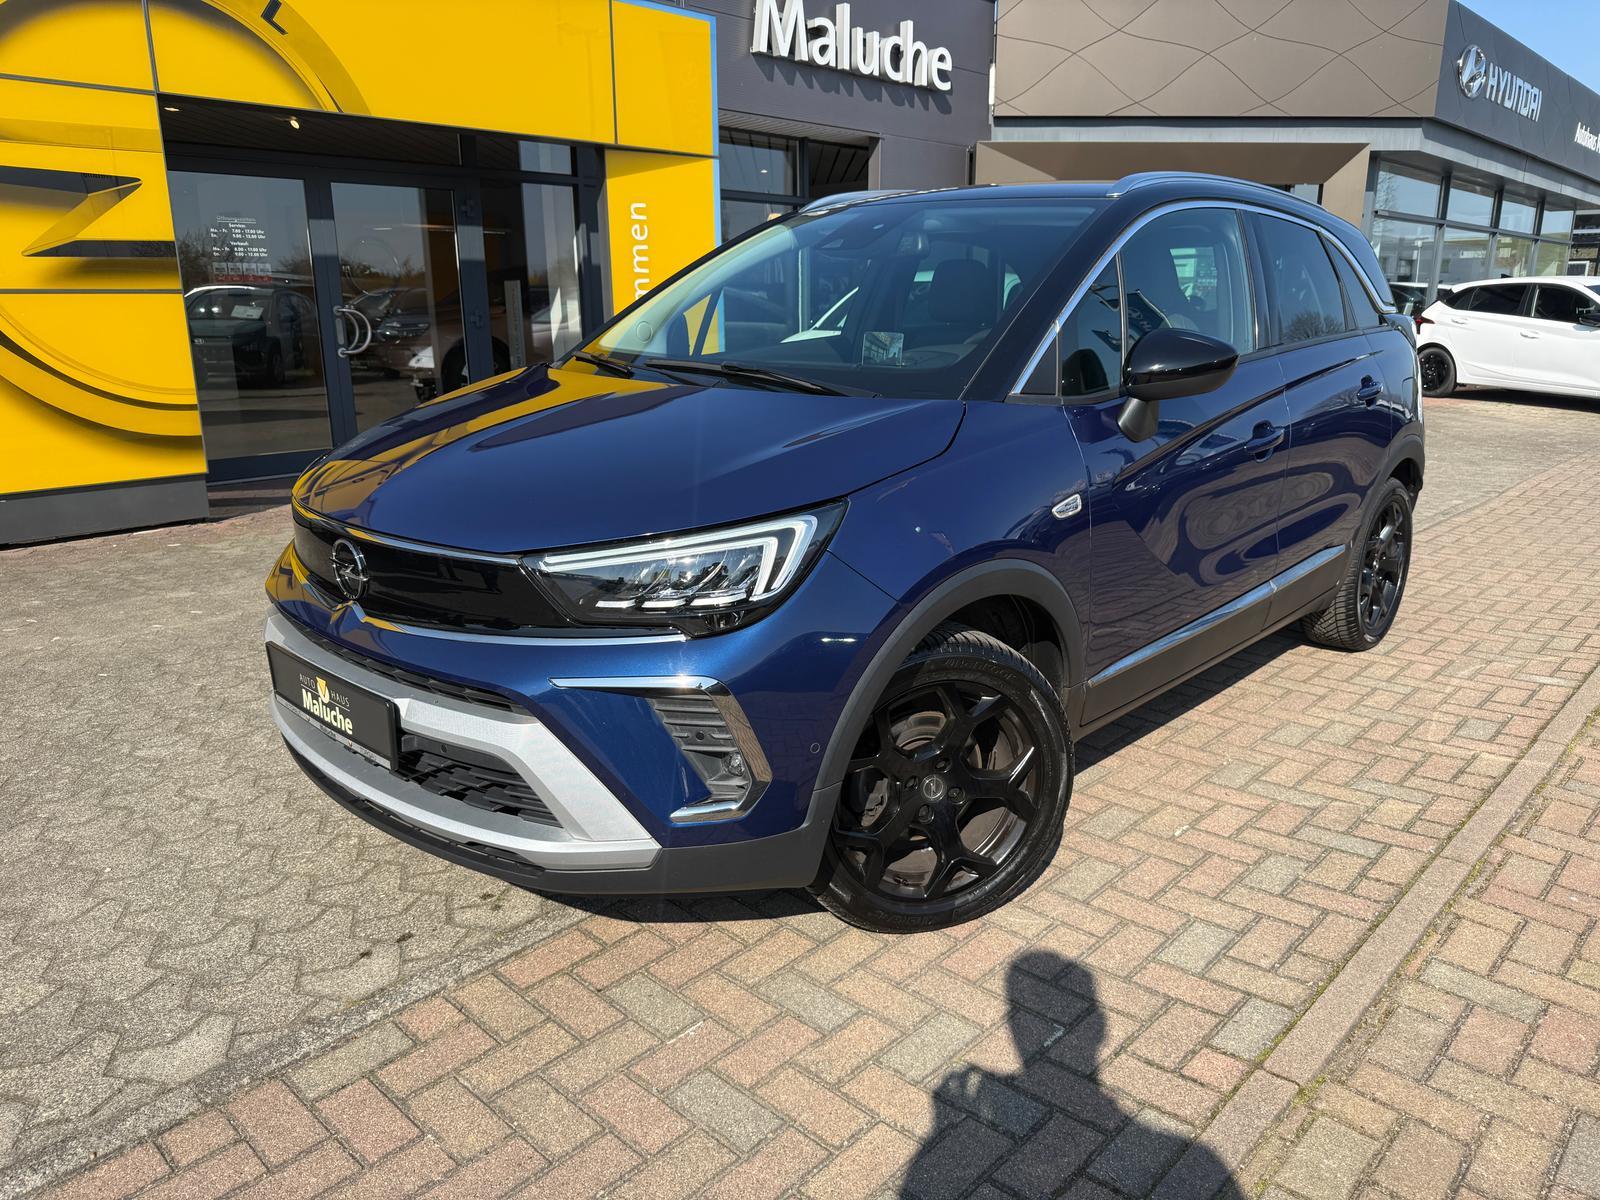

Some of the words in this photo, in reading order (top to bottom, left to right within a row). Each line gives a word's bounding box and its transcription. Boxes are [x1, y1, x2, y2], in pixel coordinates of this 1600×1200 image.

[751, 0, 953, 91] Maluche
[1485, 62, 1543, 122] HYUNDAI
[299, 673, 316, 689] AUTO
[330, 690, 351, 708] HAUS
[301, 688, 353, 735] Maluche
